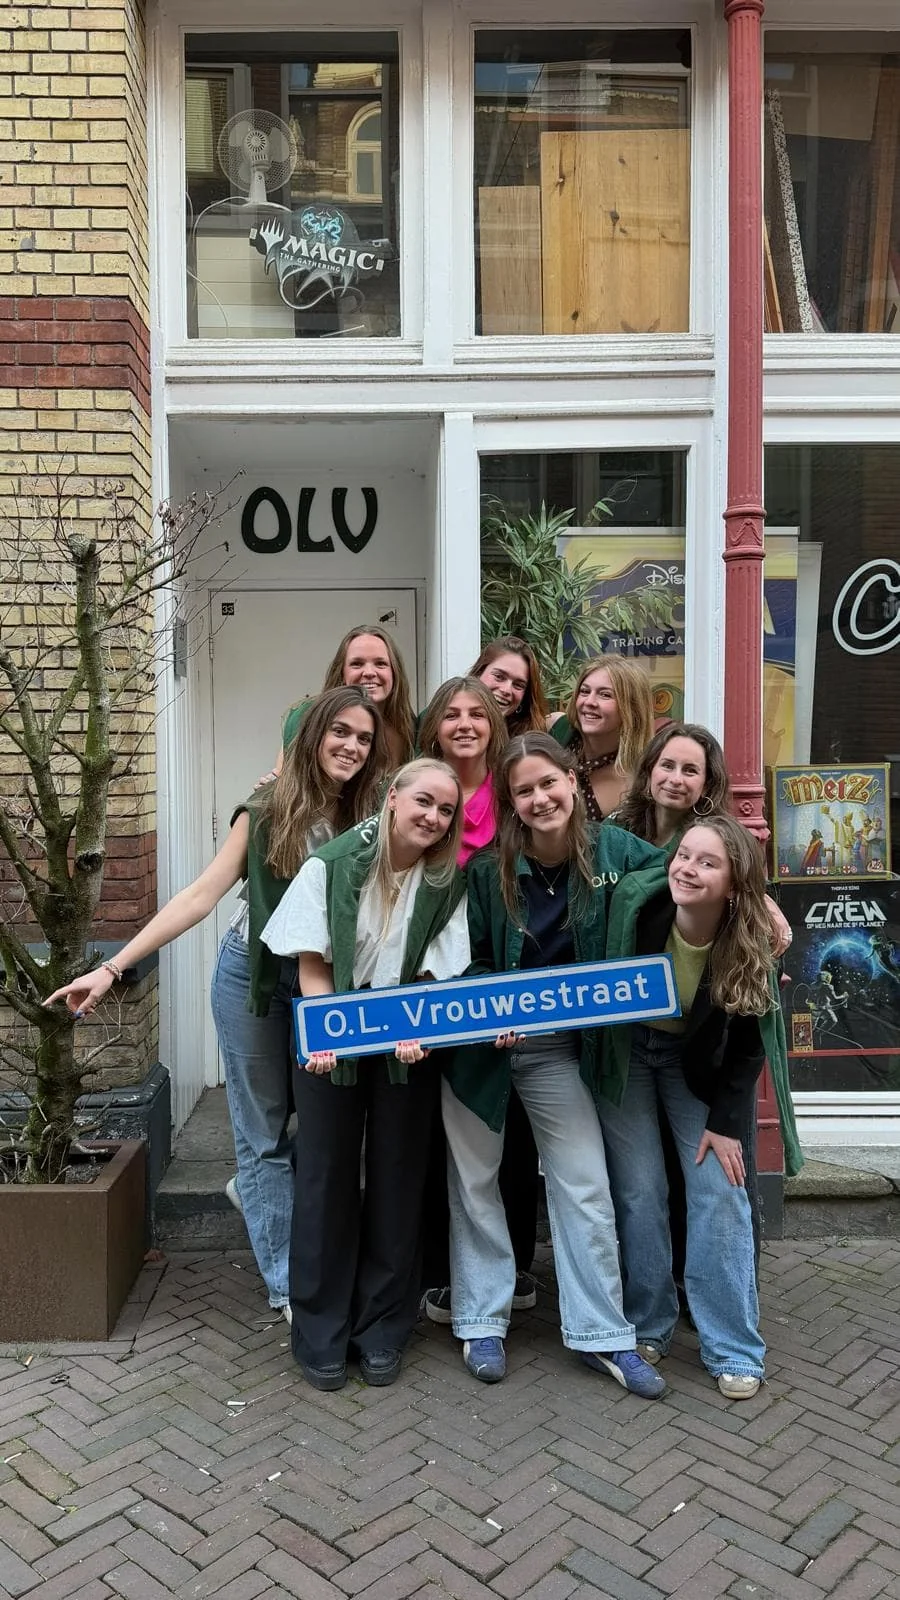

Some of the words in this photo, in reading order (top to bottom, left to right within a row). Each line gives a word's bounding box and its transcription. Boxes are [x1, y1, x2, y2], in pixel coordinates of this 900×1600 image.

[280, 252, 295, 260] THE
[298, 257, 340, 273] GATHERING
[281, 235, 375, 270] MAGIC
[241, 486, 378, 553] OLV
[642, 564, 685, 586] Dis
[612, 636, 663, 648] TRADING
[805, 901, 887, 923] CREW
[324, 1006, 390, 1038] O.L.
[401, 972, 650, 1028] Vrouwestraat
